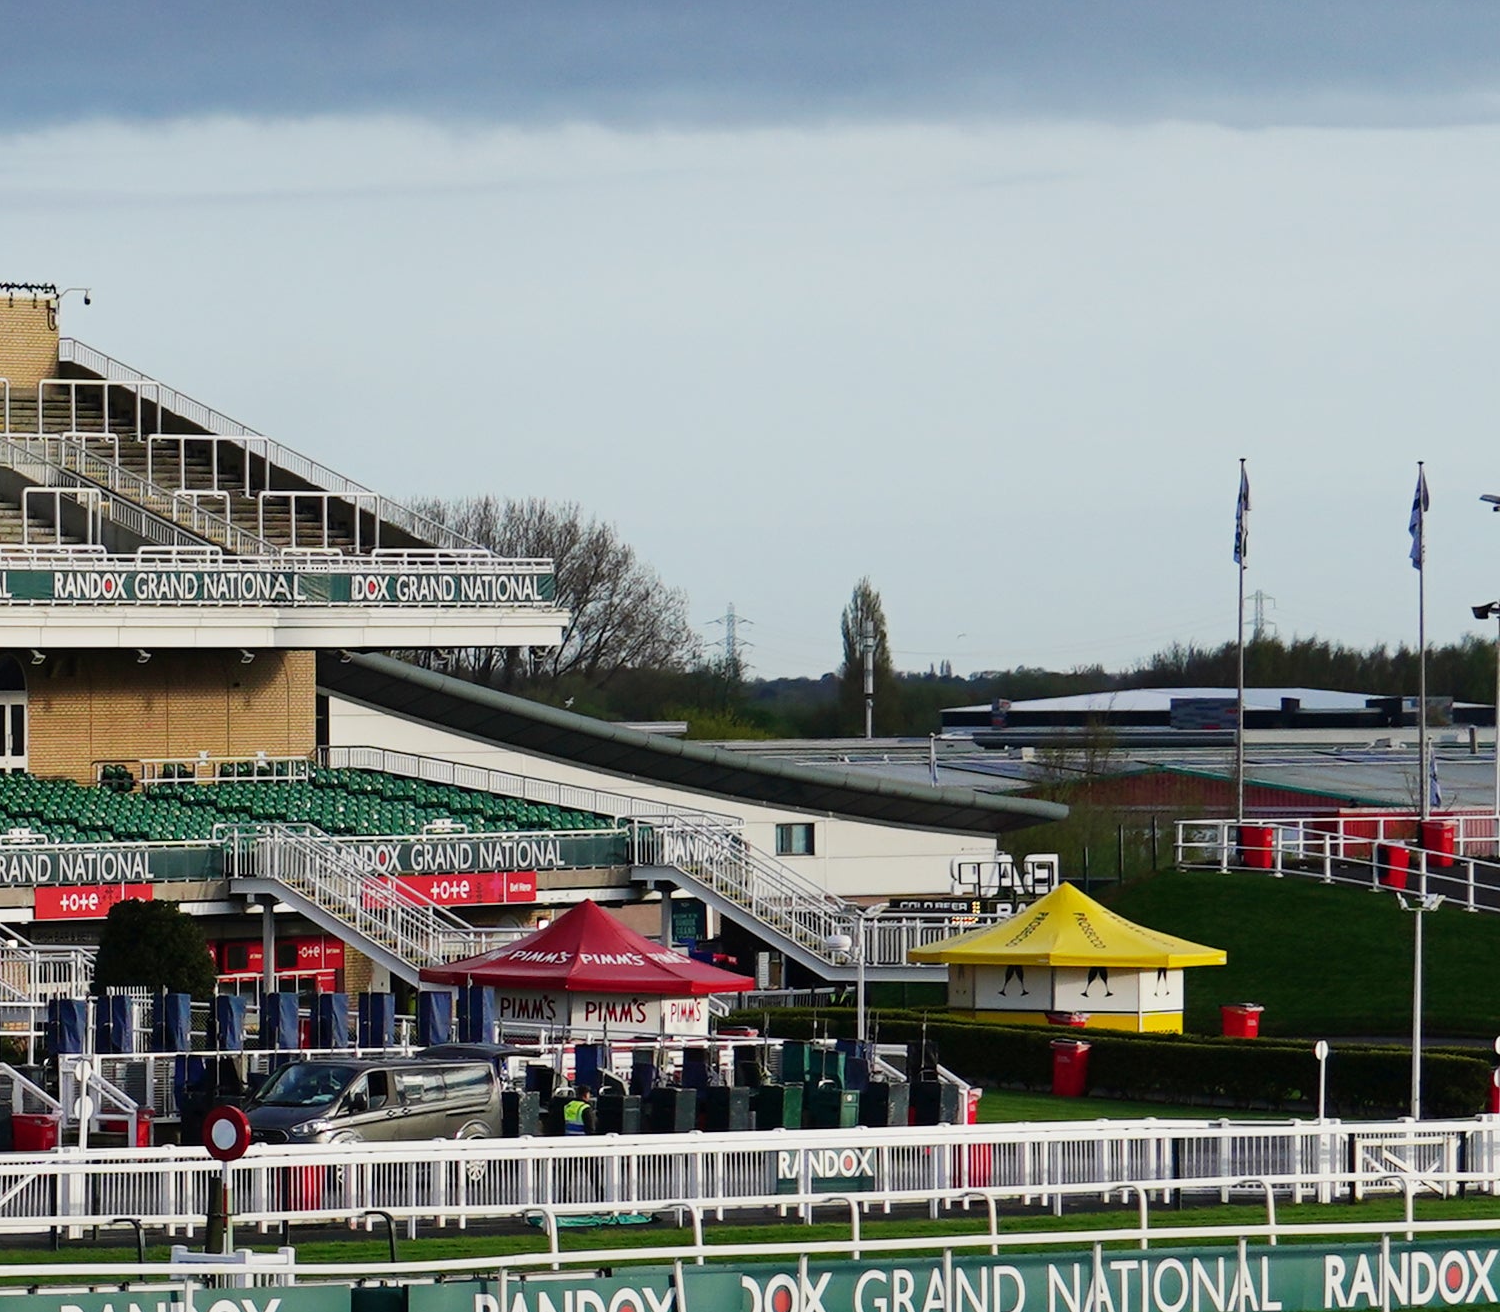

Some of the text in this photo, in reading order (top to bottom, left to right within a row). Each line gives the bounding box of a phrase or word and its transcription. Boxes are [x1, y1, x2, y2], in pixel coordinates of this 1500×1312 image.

[54, 572, 306, 601] RANDOX GRAND NATIONAL
[397, 576, 455, 602] GRAND
[460, 575, 542, 602] NATIONAL
[58, 852, 154, 882] NATIONAL
[410, 843, 473, 870] GRAND
[479, 841, 565, 869] NATIONAL
[59, 891, 99, 912] tote
[430, 880, 470, 900] tote
[1073, 911, 1107, 950] PROSECCO
[509, 950, 573, 965] PIMM'S
[579, 952, 646, 967] PIMM'S
[500, 994, 557, 1020] PIMM'S
[585, 997, 648, 1024] PIMM'S
[669, 997, 702, 1024] PIMM'S
[1325, 1247, 1500, 1311] RANDOX
